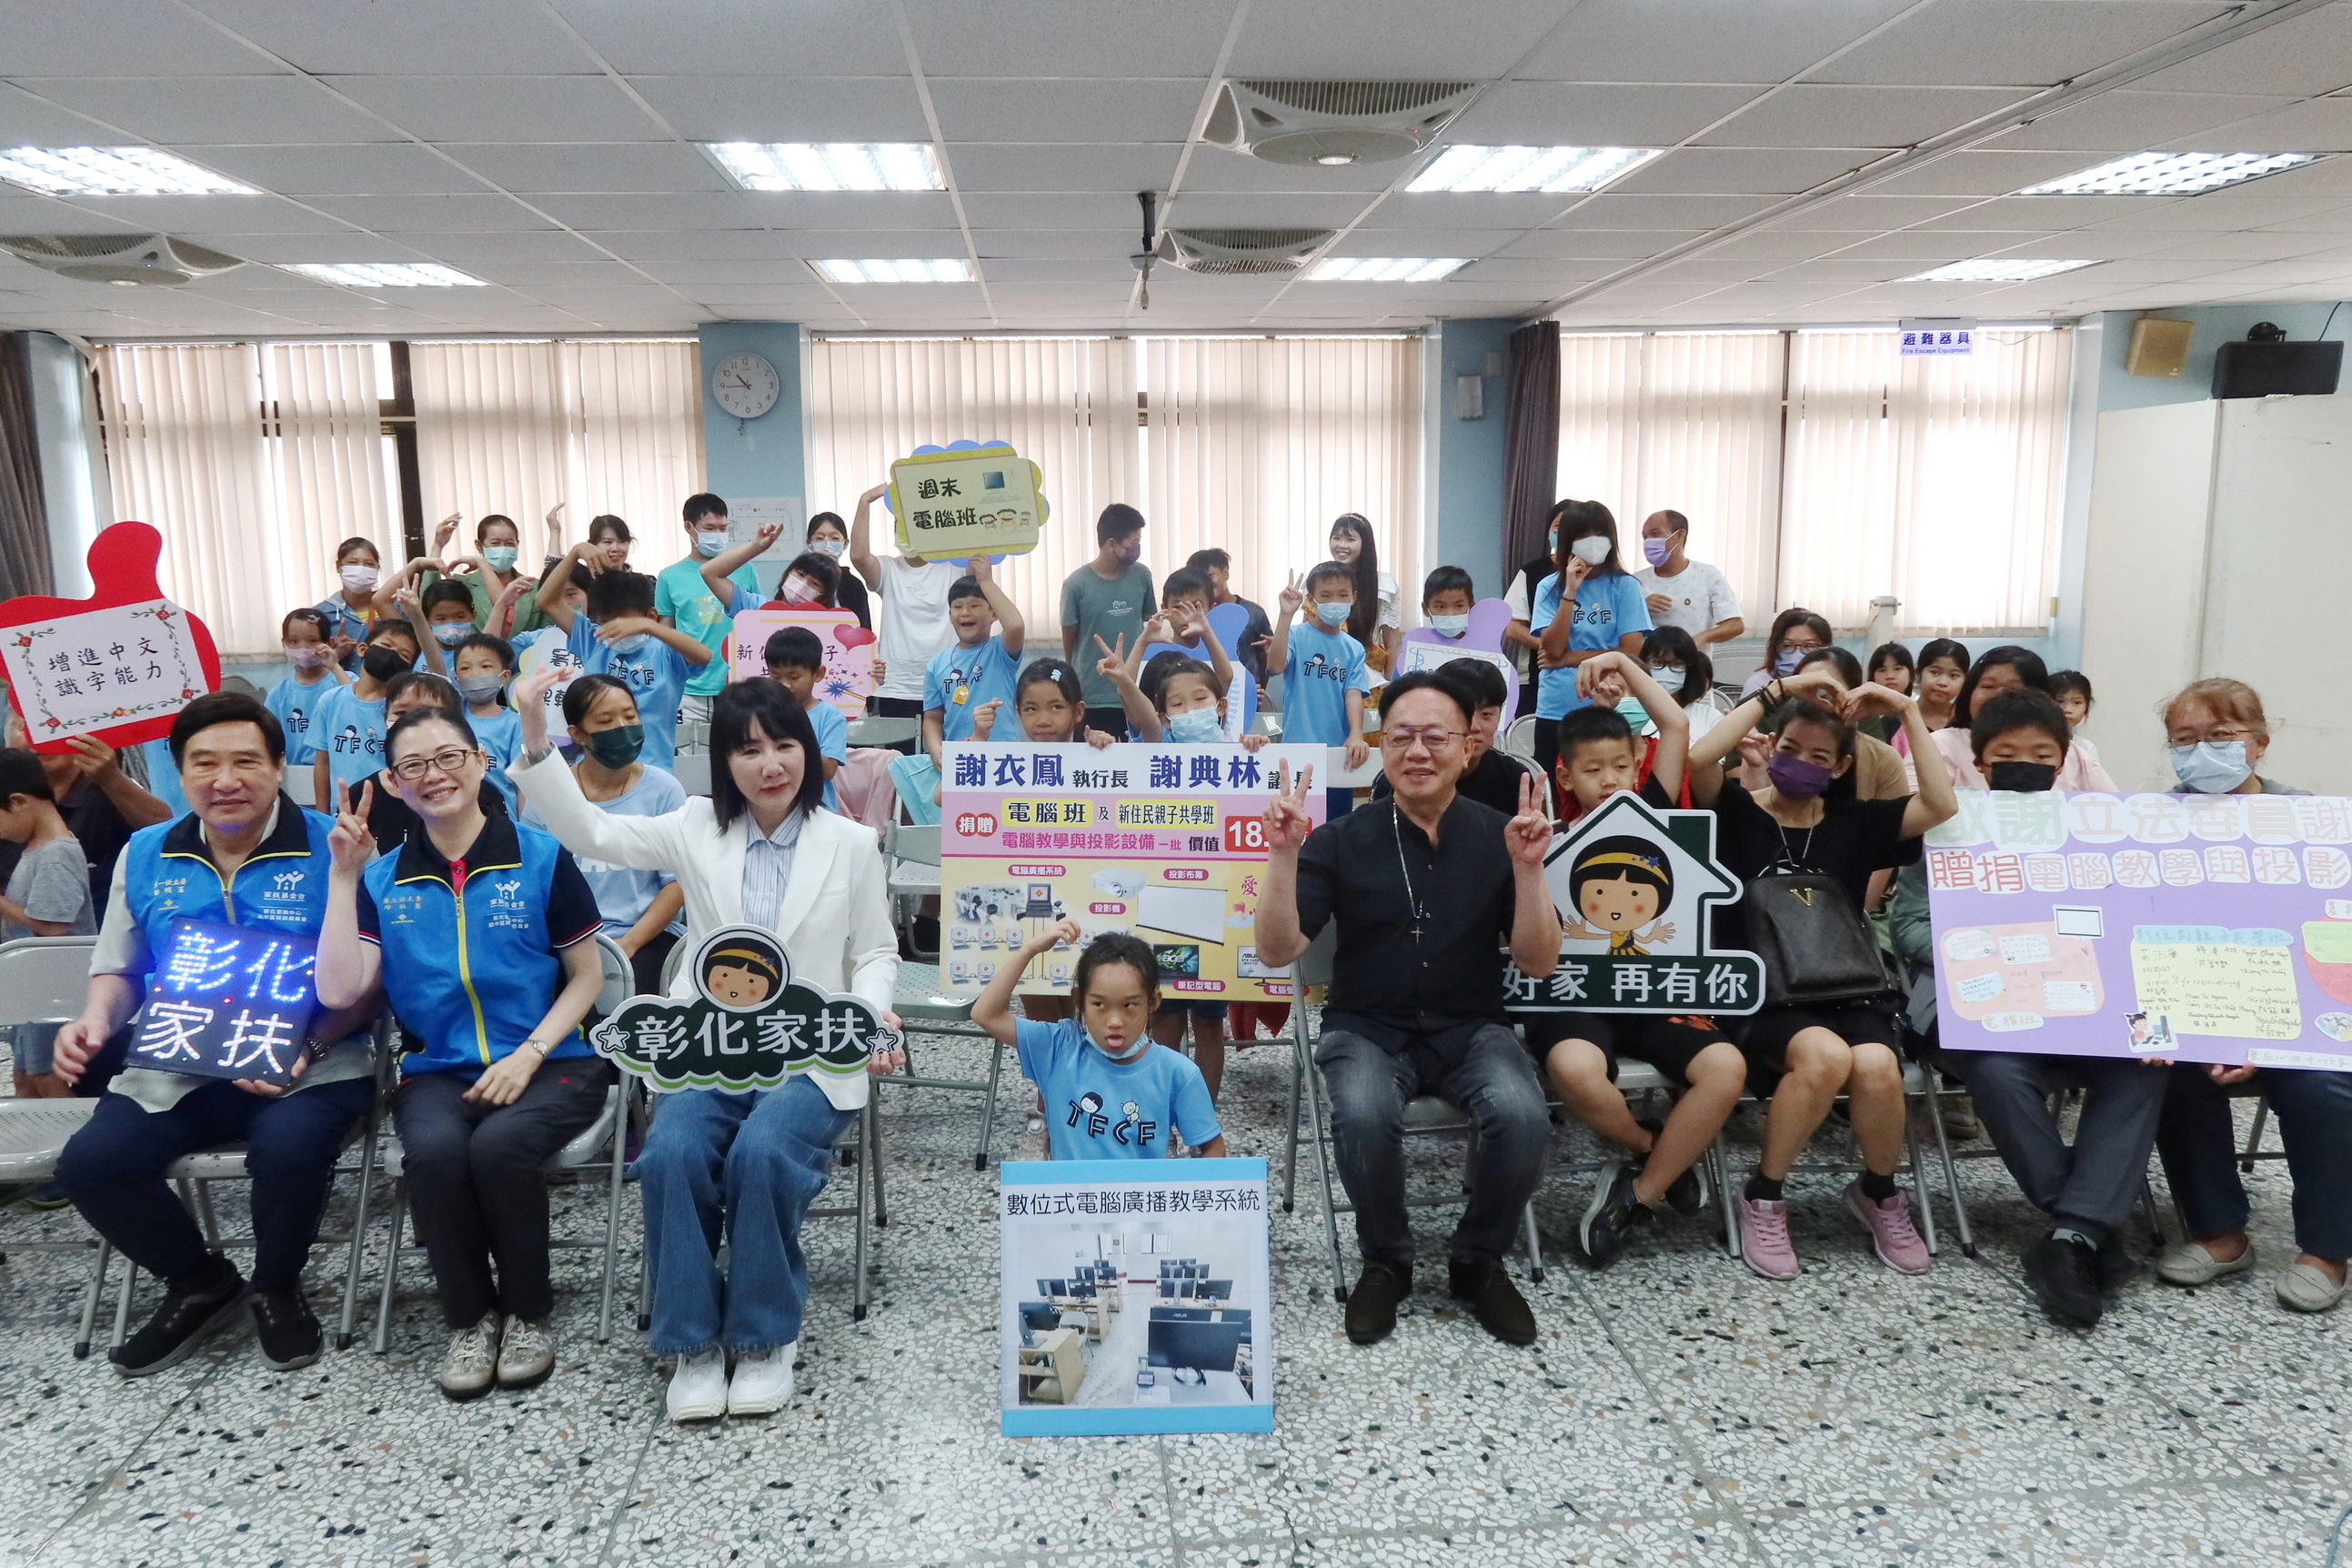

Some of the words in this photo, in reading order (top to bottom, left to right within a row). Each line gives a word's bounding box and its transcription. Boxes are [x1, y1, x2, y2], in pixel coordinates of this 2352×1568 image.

[1903, 332, 1970, 346] 避難器具
[722, 369, 731, 377] 10
[918, 477, 961, 499] 週末
[913, 507, 978, 529] 電腦班
[1573, 610, 1612, 625] FCF
[48, 638, 158, 672] 增進中文
[55, 660, 162, 697] 識字能力
[955, 754, 1065, 787] 謝衣鳳
[1072, 769, 1129, 789] 執行長
[1150, 755, 1261, 789] 謝典林
[1008, 802, 1087, 823] 電腦班
[1098, 806, 1110, 820] 及
[1118, 803, 1214, 825] 新住民親子共學班
[959, 817, 993, 833] 捐贈
[1002, 832, 1155, 850] 電腦教學與投影設備
[1159, 839, 1181, 851] 一批
[1188, 836, 1220, 852] 價值
[1010, 866, 1063, 876] 電腦廣播系統
[1168, 869, 1204, 879] 投影布幕
[1094, 903, 1121, 913] 投影機
[1789, 887, 1813, 908] V
[165, 932, 316, 1002] 彰化
[1177, 980, 1221, 990] 筆記型電腦
[1611, 961, 1748, 1003] 再有你
[136, 1000, 294, 1073] 家扶
[635, 1008, 869, 1061] 彰化家扶
[1066, 1098, 1157, 1147] TFCF
[1007, 1188, 1261, 1216] 數位式電腦廣播教學系統
